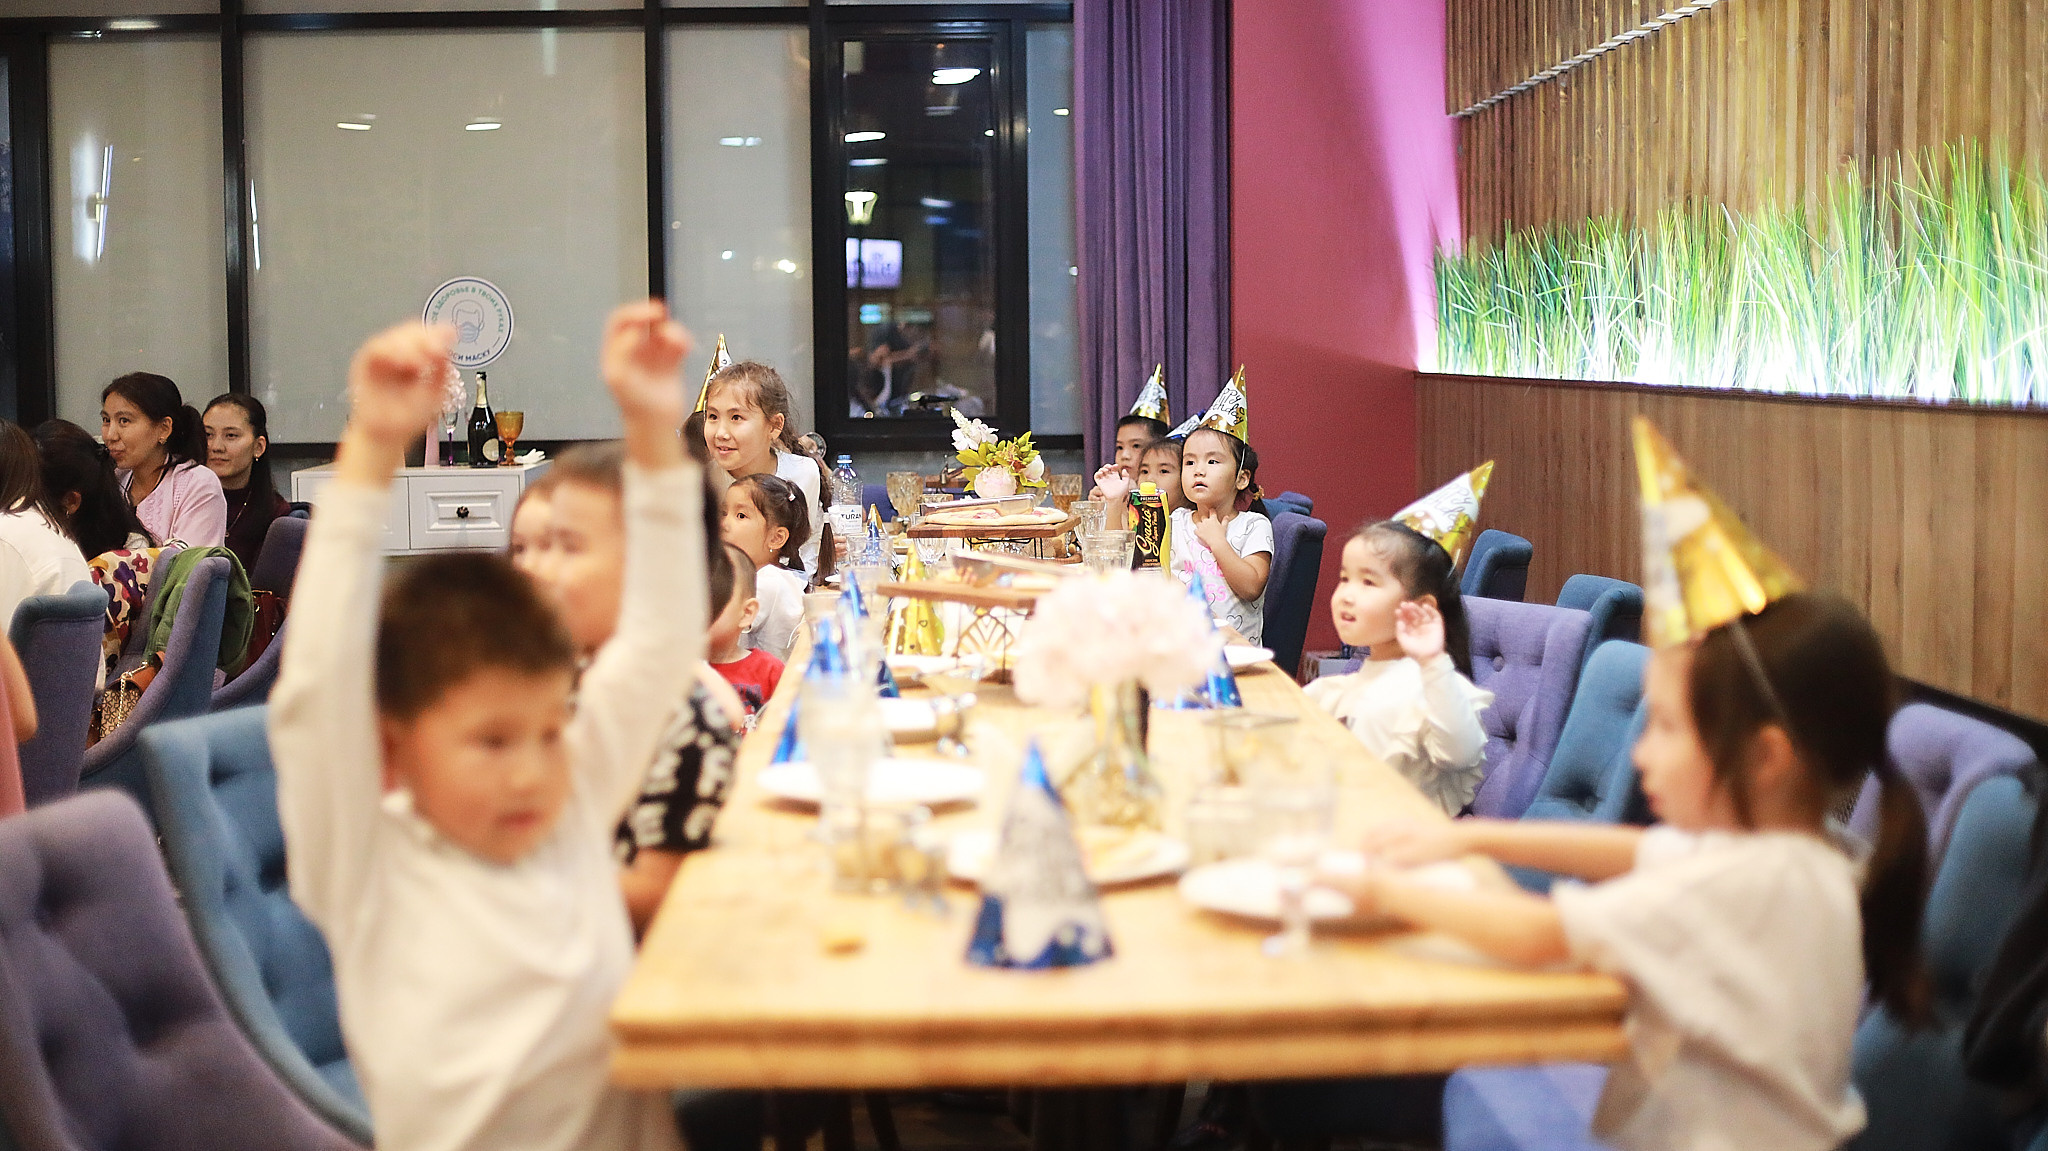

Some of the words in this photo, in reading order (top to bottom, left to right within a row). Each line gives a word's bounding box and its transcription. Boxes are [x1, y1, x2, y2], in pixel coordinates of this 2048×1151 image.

[435, 287, 469, 309] ЗДОРОВЬЕ
[479, 288, 498, 307] ТВОИХ
[465, 349, 490, 361] МАСКУ
[1136, 508, 1159, 556] Gracio
